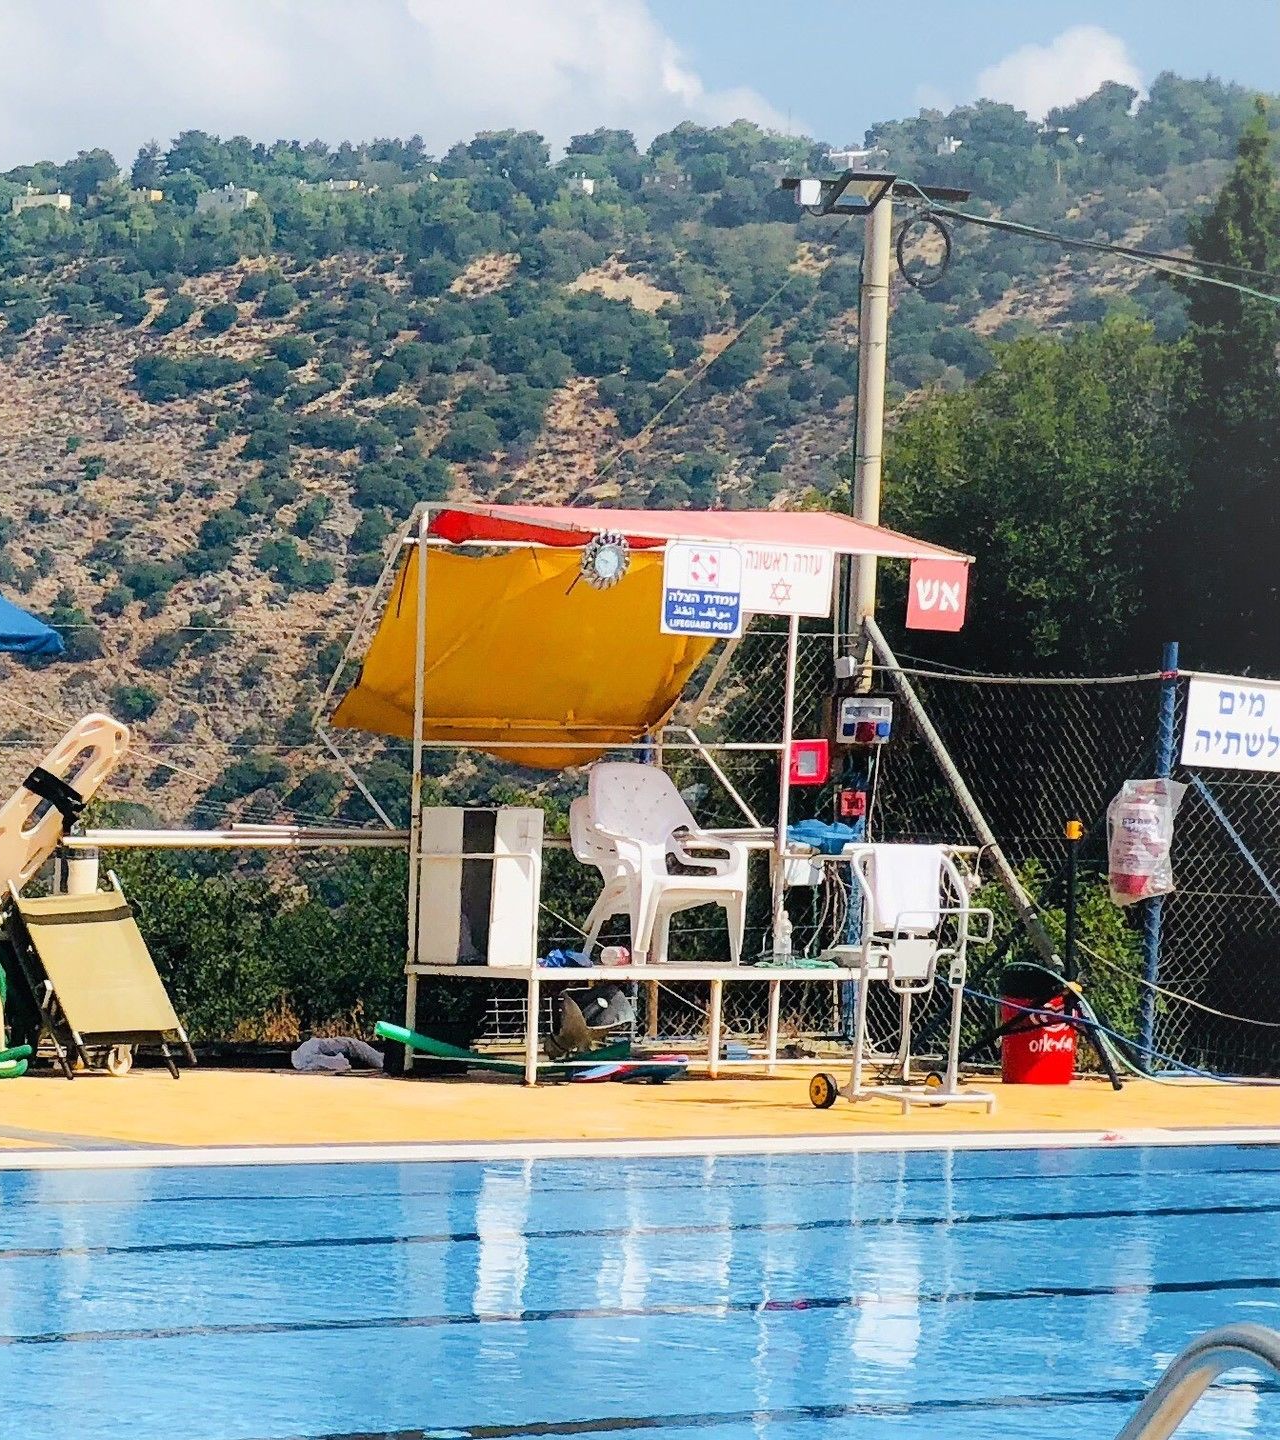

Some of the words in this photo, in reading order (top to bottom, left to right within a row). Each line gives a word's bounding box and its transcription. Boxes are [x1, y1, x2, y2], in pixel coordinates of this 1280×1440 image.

[746, 550, 788, 572] ראשונה
[793, 553, 822, 576] עזרה
[668, 590, 700, 603] הצלה
[703, 594, 738, 606] עמדת
[916, 577, 960, 612] אש
[669, 619, 711, 629] LIFEGUARD
[712, 621, 734, 631] POST
[1219, 690, 1265, 717] מים
[1194, 725, 1280, 758] לשתיה
